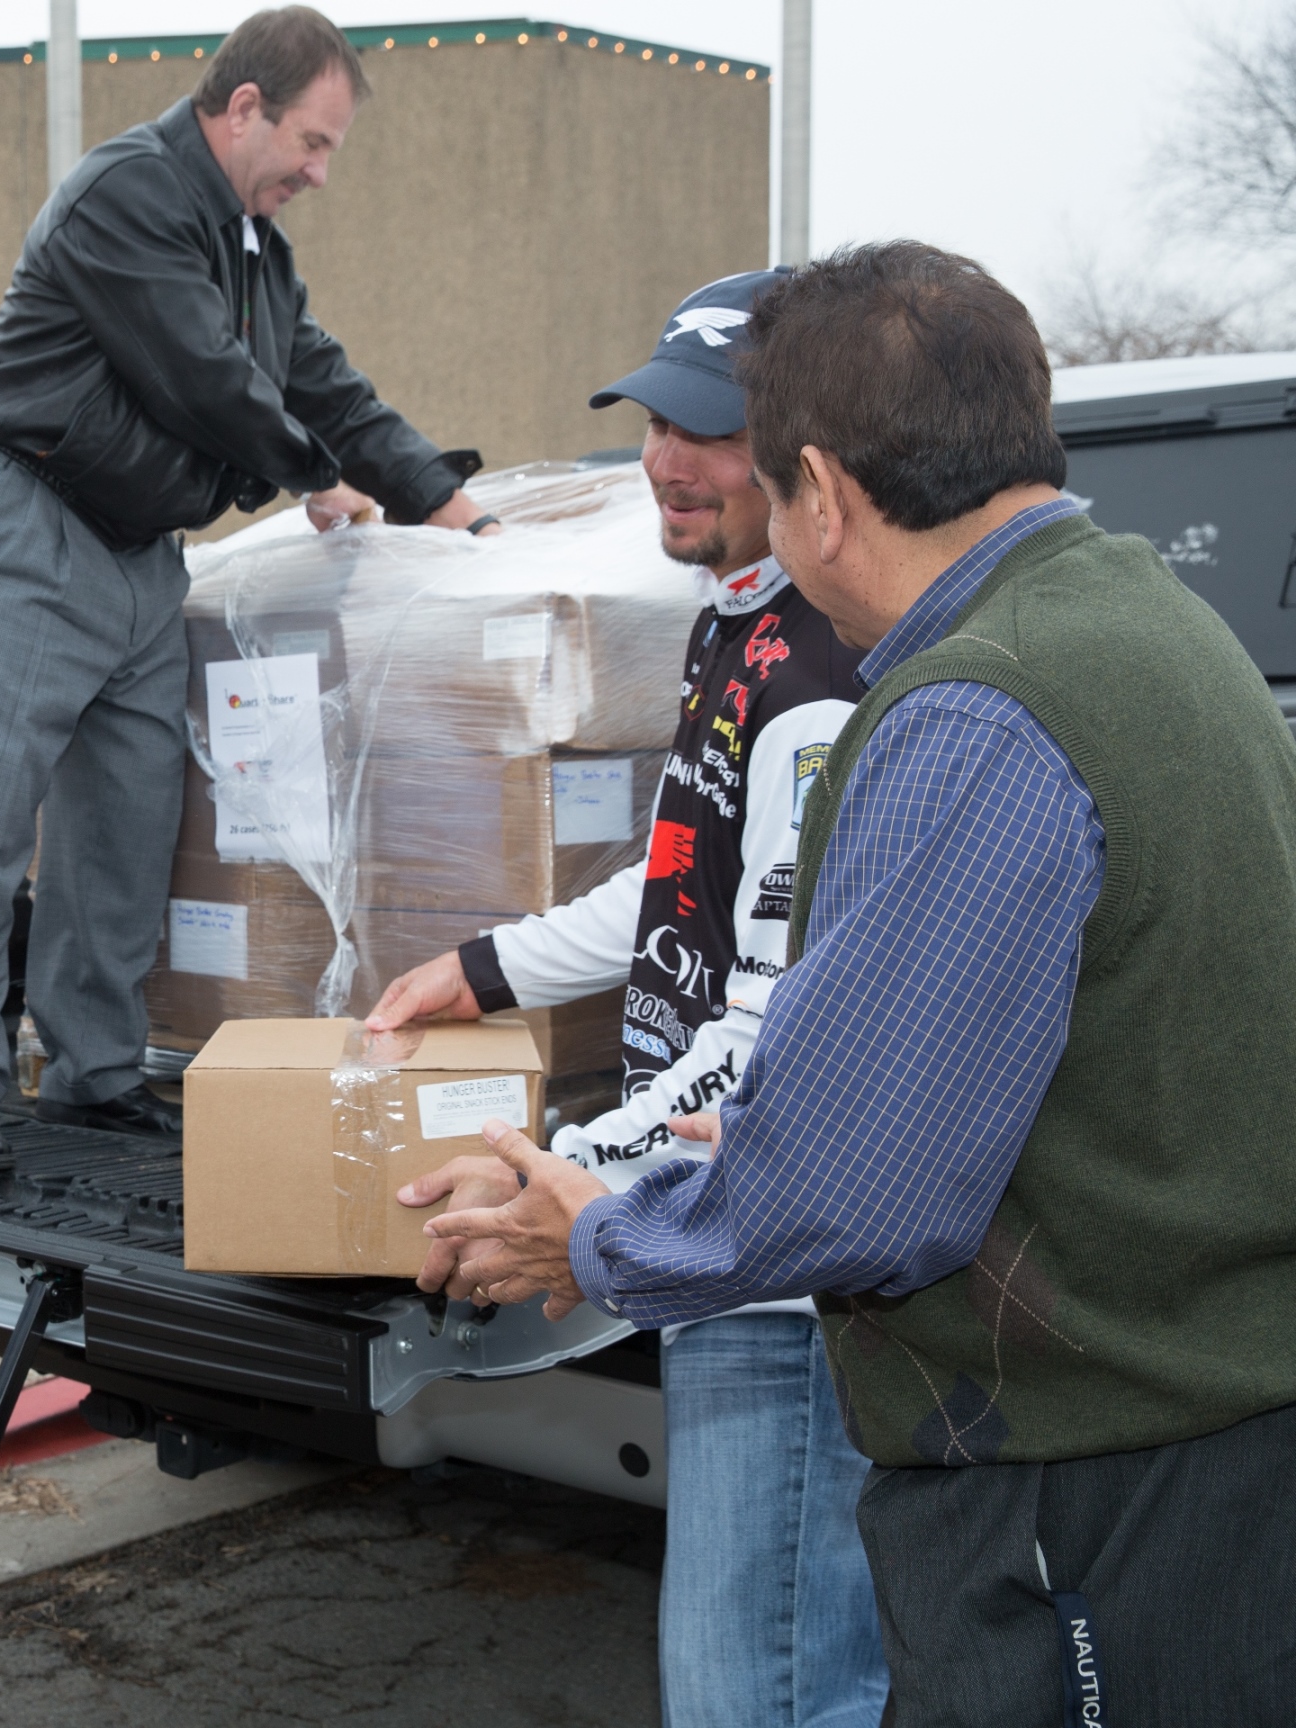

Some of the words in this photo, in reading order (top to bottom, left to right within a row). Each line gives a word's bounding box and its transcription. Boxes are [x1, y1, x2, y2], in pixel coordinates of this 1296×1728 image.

[441, 1082, 476, 1098] HUNGER
[436, 1100, 464, 1112] ORIGINAL
[464, 1097, 483, 1109] SNACK
[484, 1096, 500, 1106] STICK
[501, 1094, 517, 1104] ENDS
